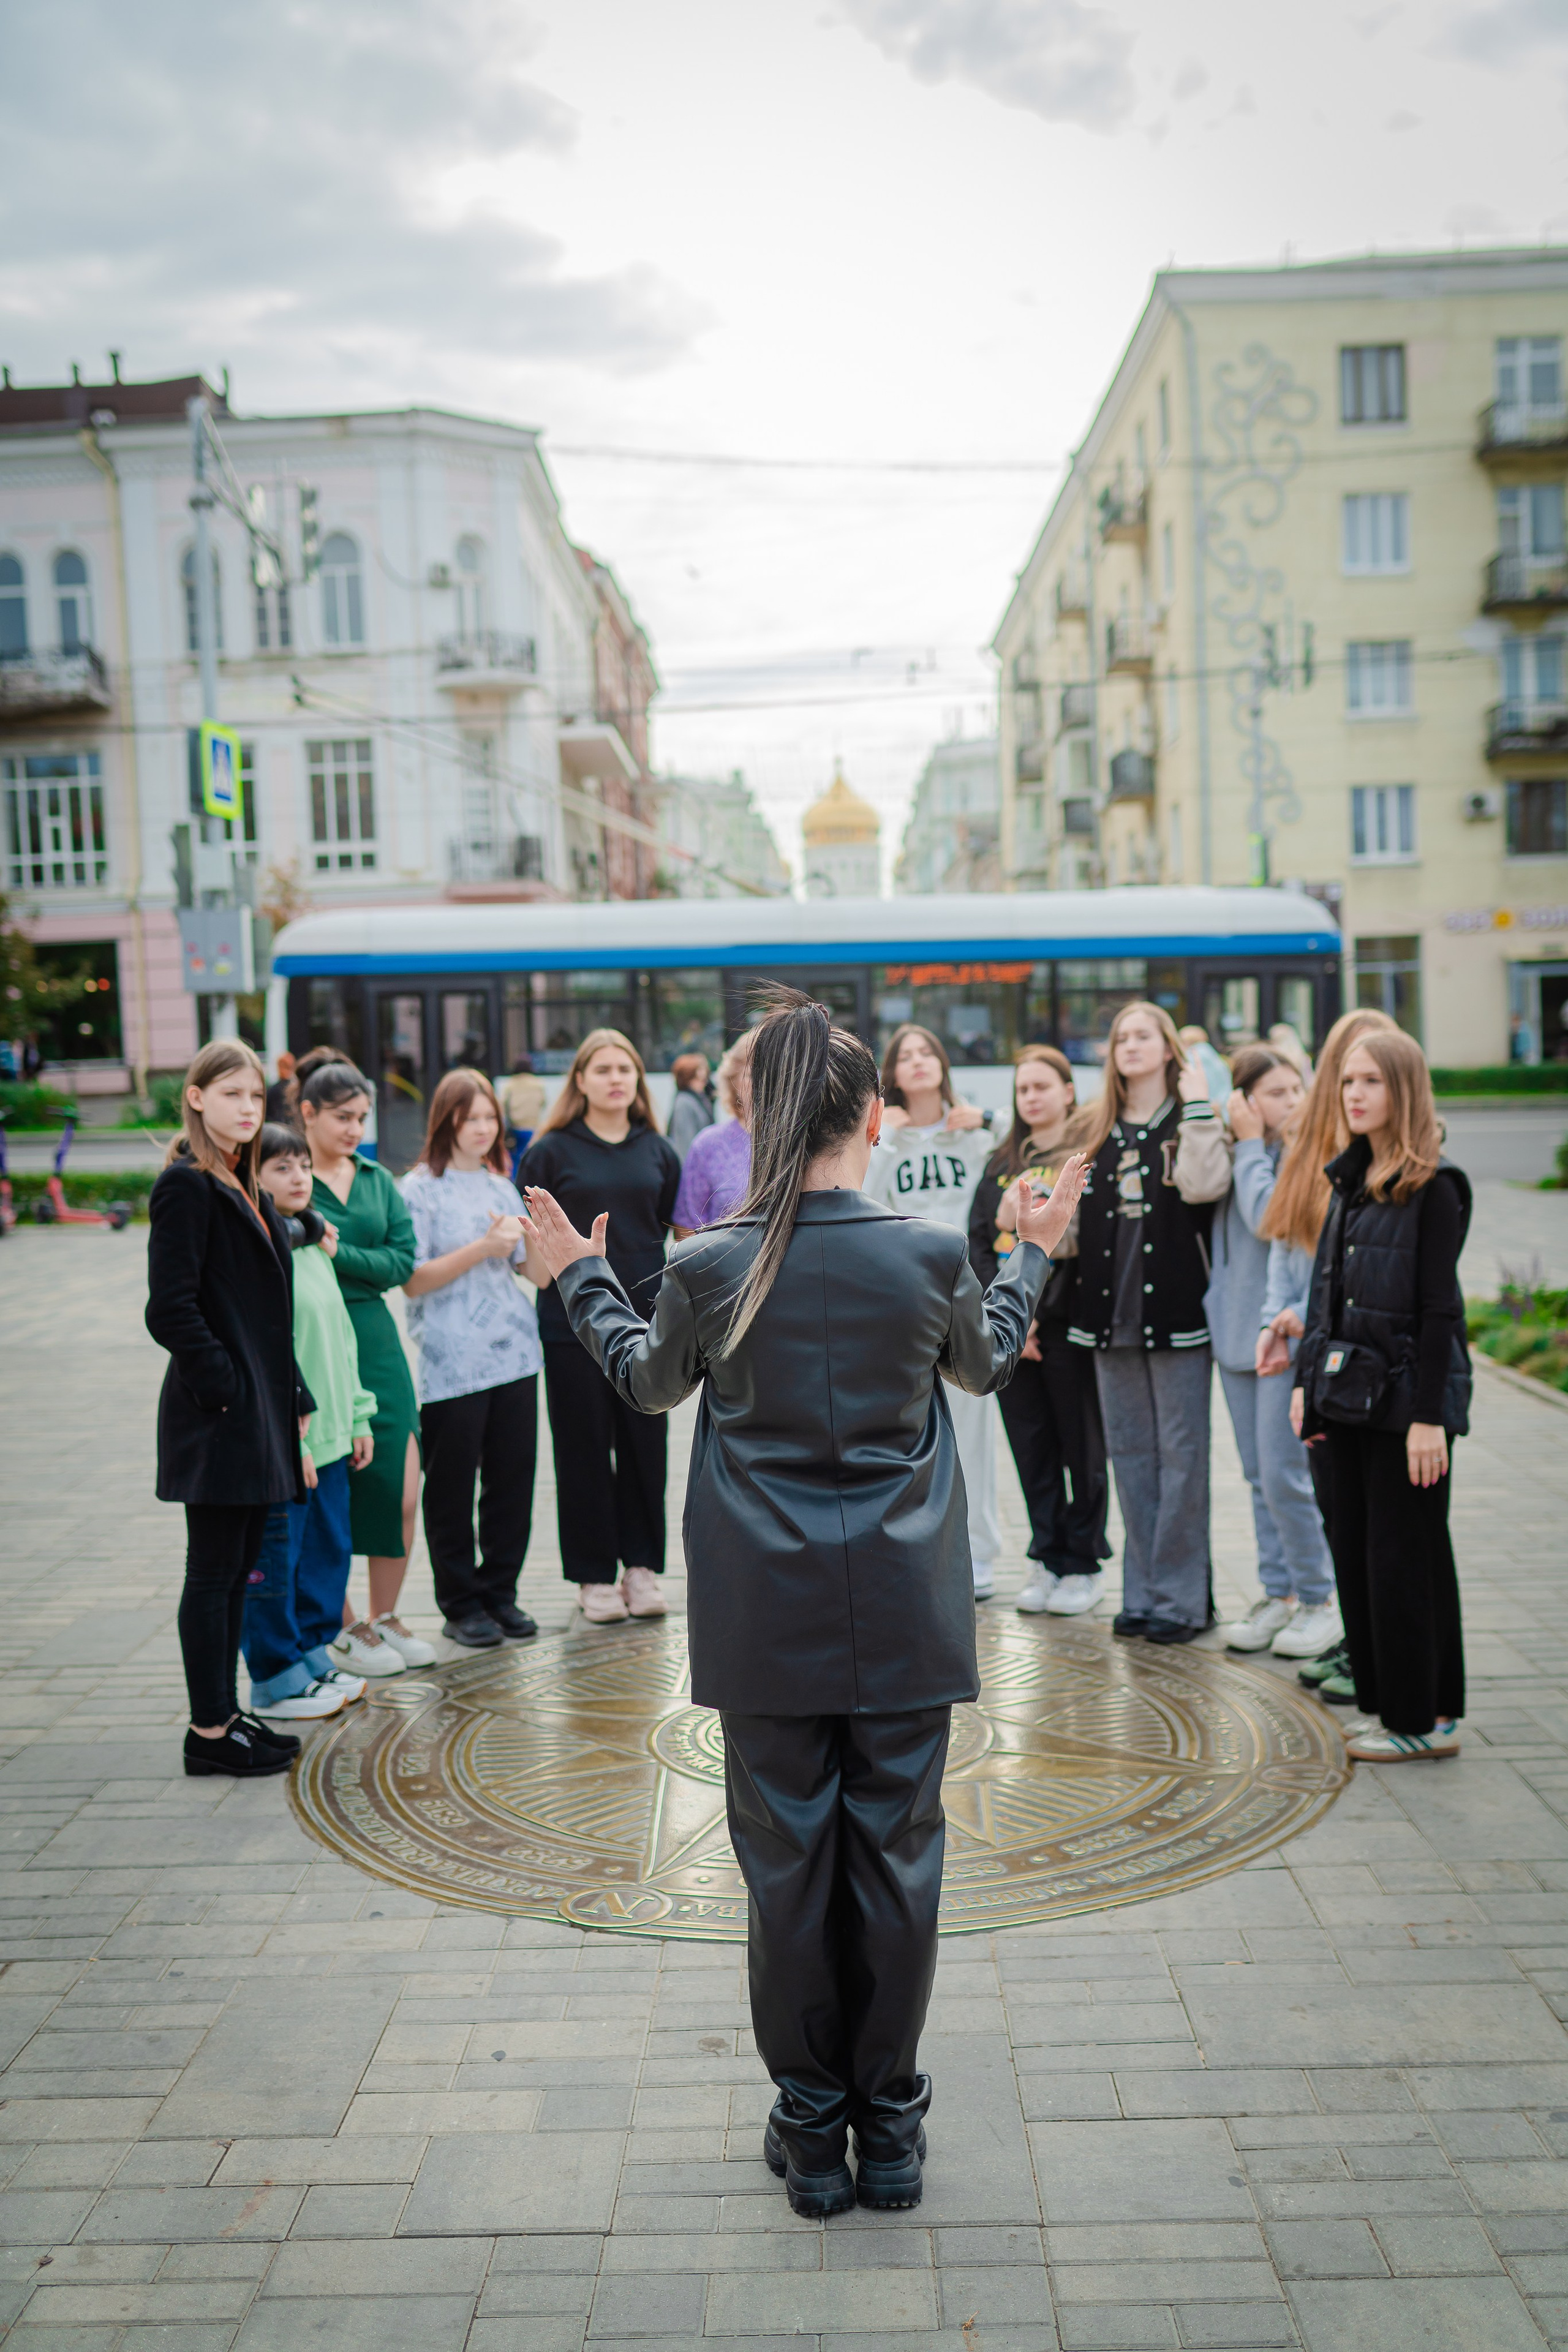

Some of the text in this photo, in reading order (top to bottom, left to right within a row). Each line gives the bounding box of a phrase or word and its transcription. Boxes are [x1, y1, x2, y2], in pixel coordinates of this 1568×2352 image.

[897, 1155, 967, 1193] GAP
[417, 1798, 469, 1828] 6819
[1061, 1825, 1144, 1855] 2896
[1097, 1838, 1214, 1882] ЛОНДОН
[428, 1860, 557, 1898] АРКТИКА
[577, 1892, 655, 1919] N
[937, 1880, 1088, 1912] ВАШИНГ
